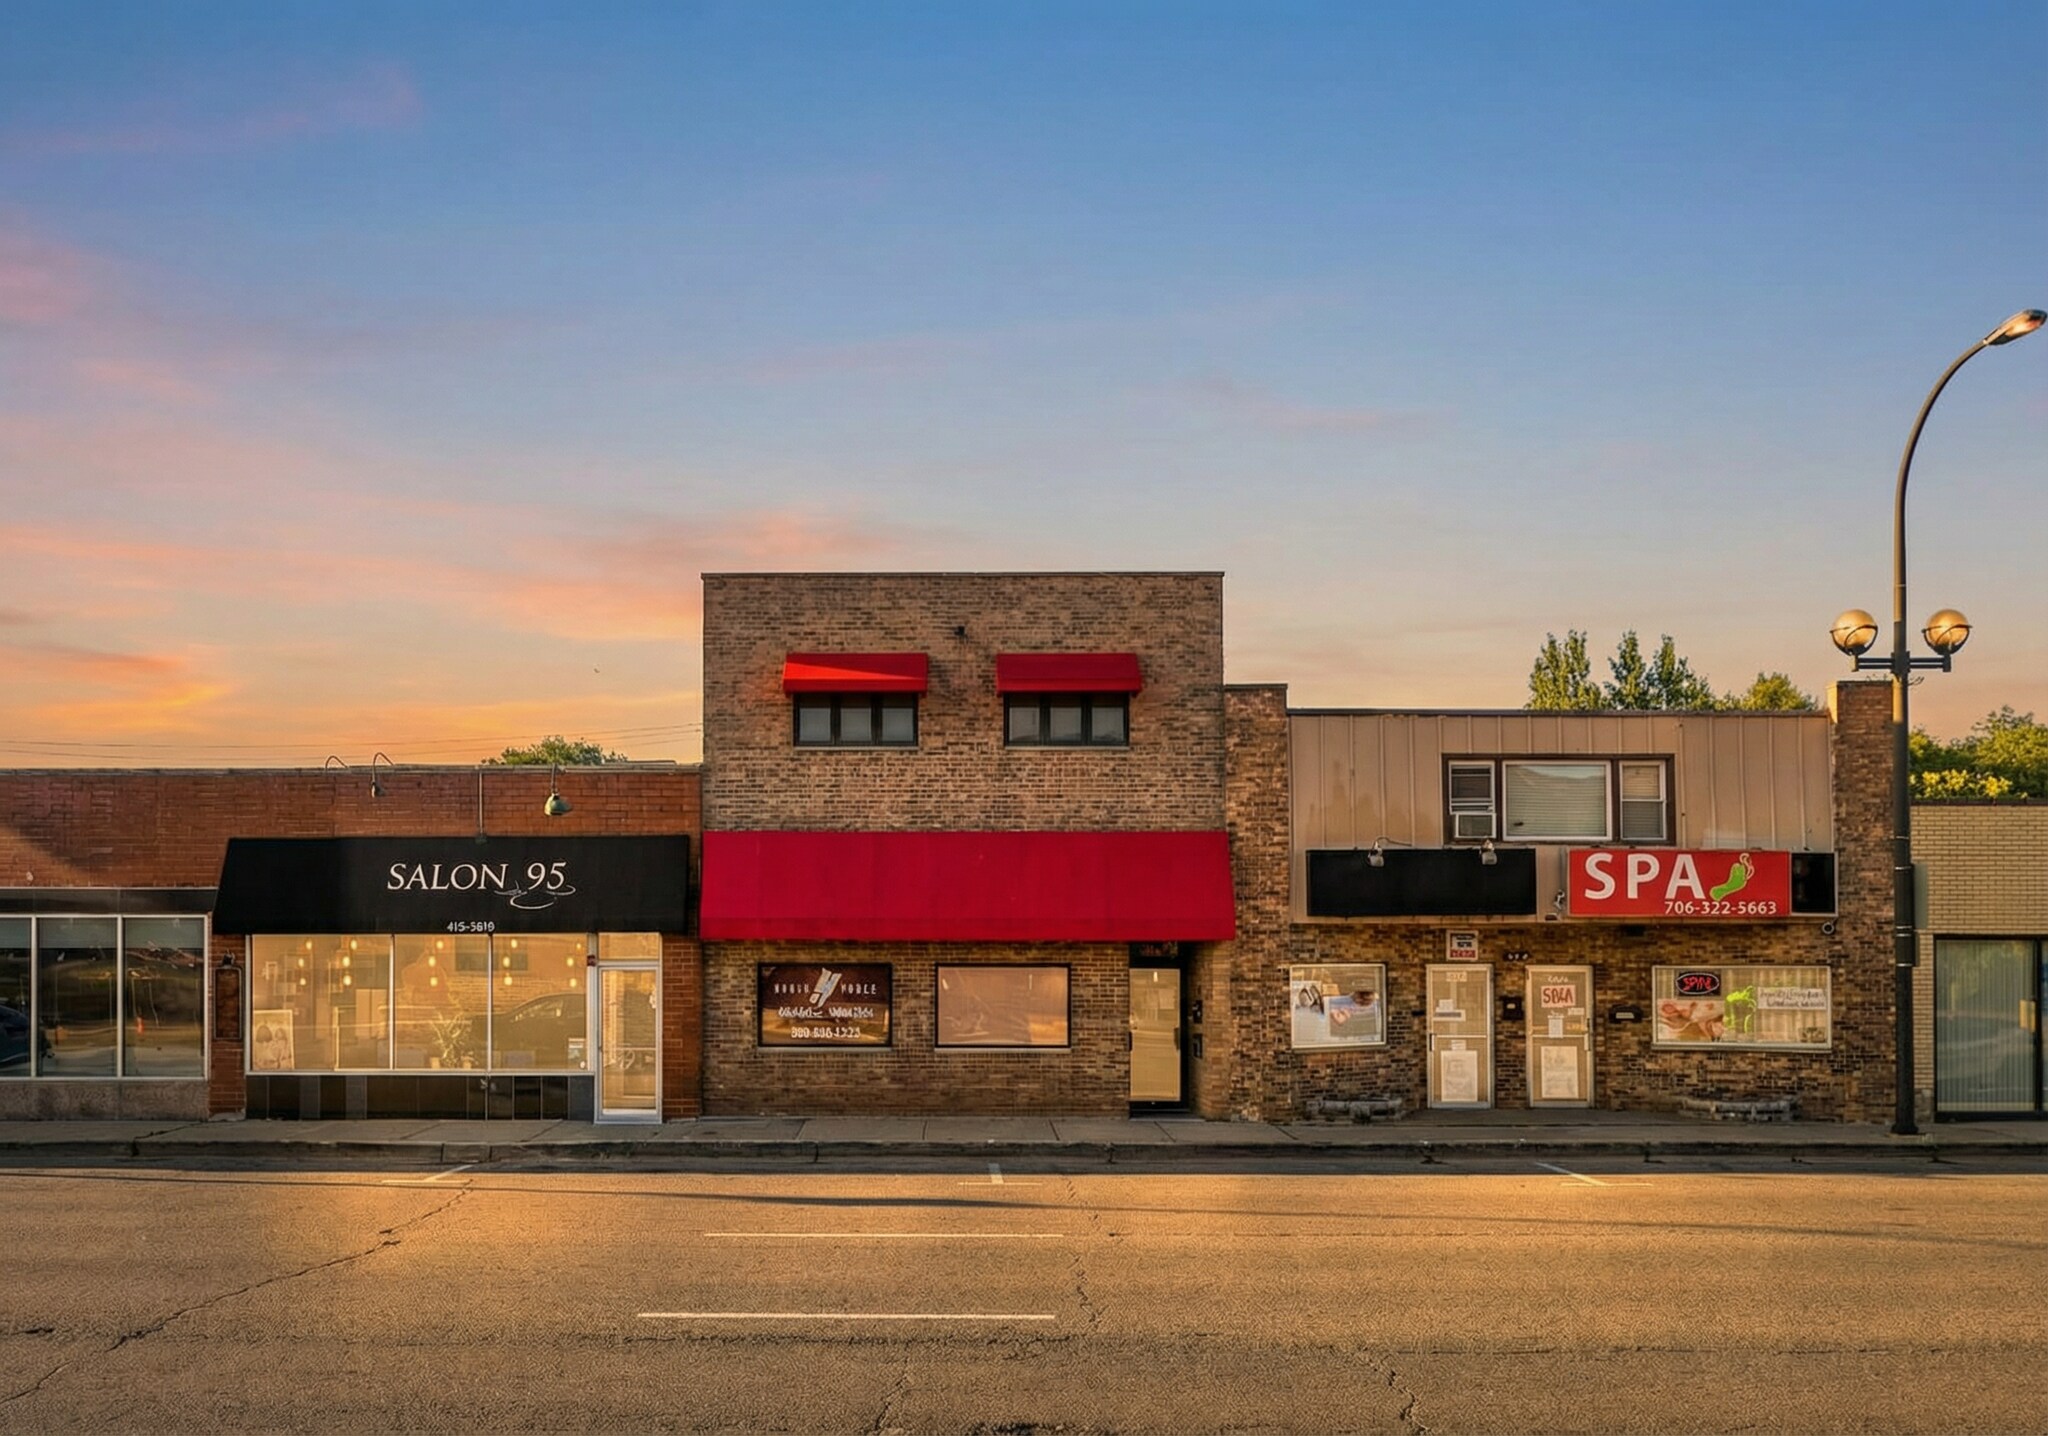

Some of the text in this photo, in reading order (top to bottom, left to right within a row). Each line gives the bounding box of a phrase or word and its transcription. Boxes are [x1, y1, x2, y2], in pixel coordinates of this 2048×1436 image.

[387, 862, 567, 891] SALON 95
[1584, 852, 1706, 900] SPA
[1664, 900, 1777, 915] 706-322-5663
